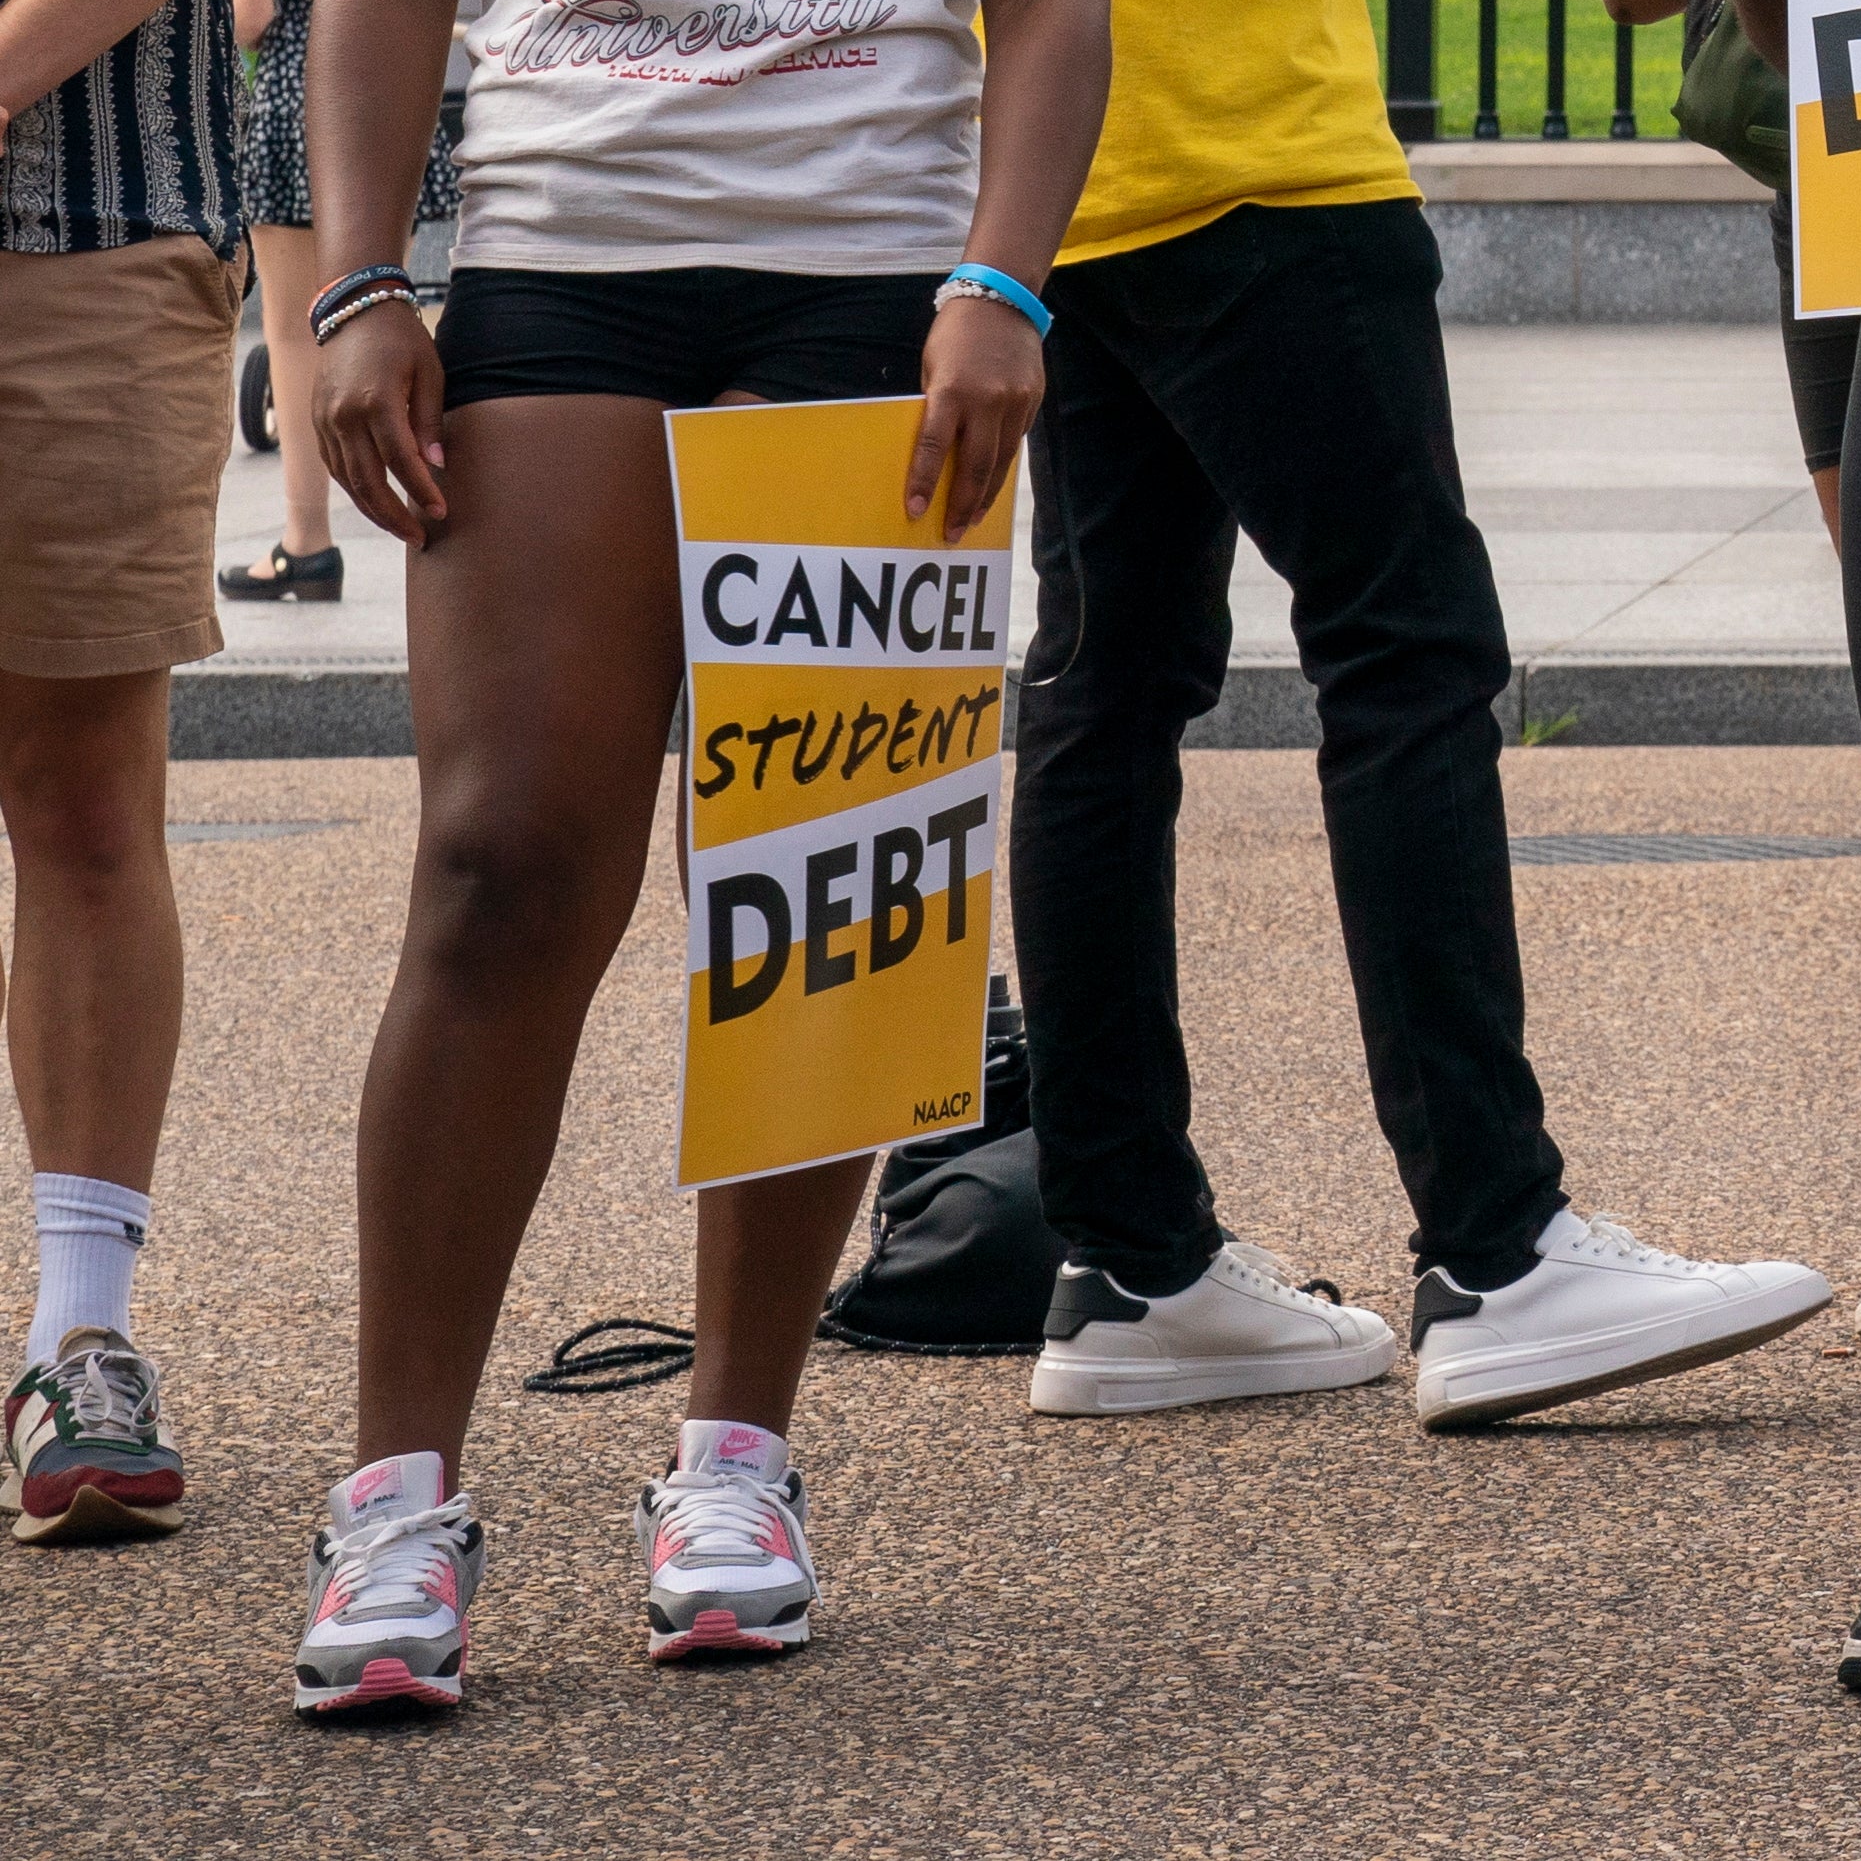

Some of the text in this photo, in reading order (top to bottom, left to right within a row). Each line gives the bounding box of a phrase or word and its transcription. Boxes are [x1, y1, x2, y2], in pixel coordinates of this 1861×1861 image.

[702, 553, 995, 653] CANCEL
[693, 684, 999, 800] STUDENT
[707, 793, 989, 1026] DEBT
[912, 1093, 971, 1126] NAACP
